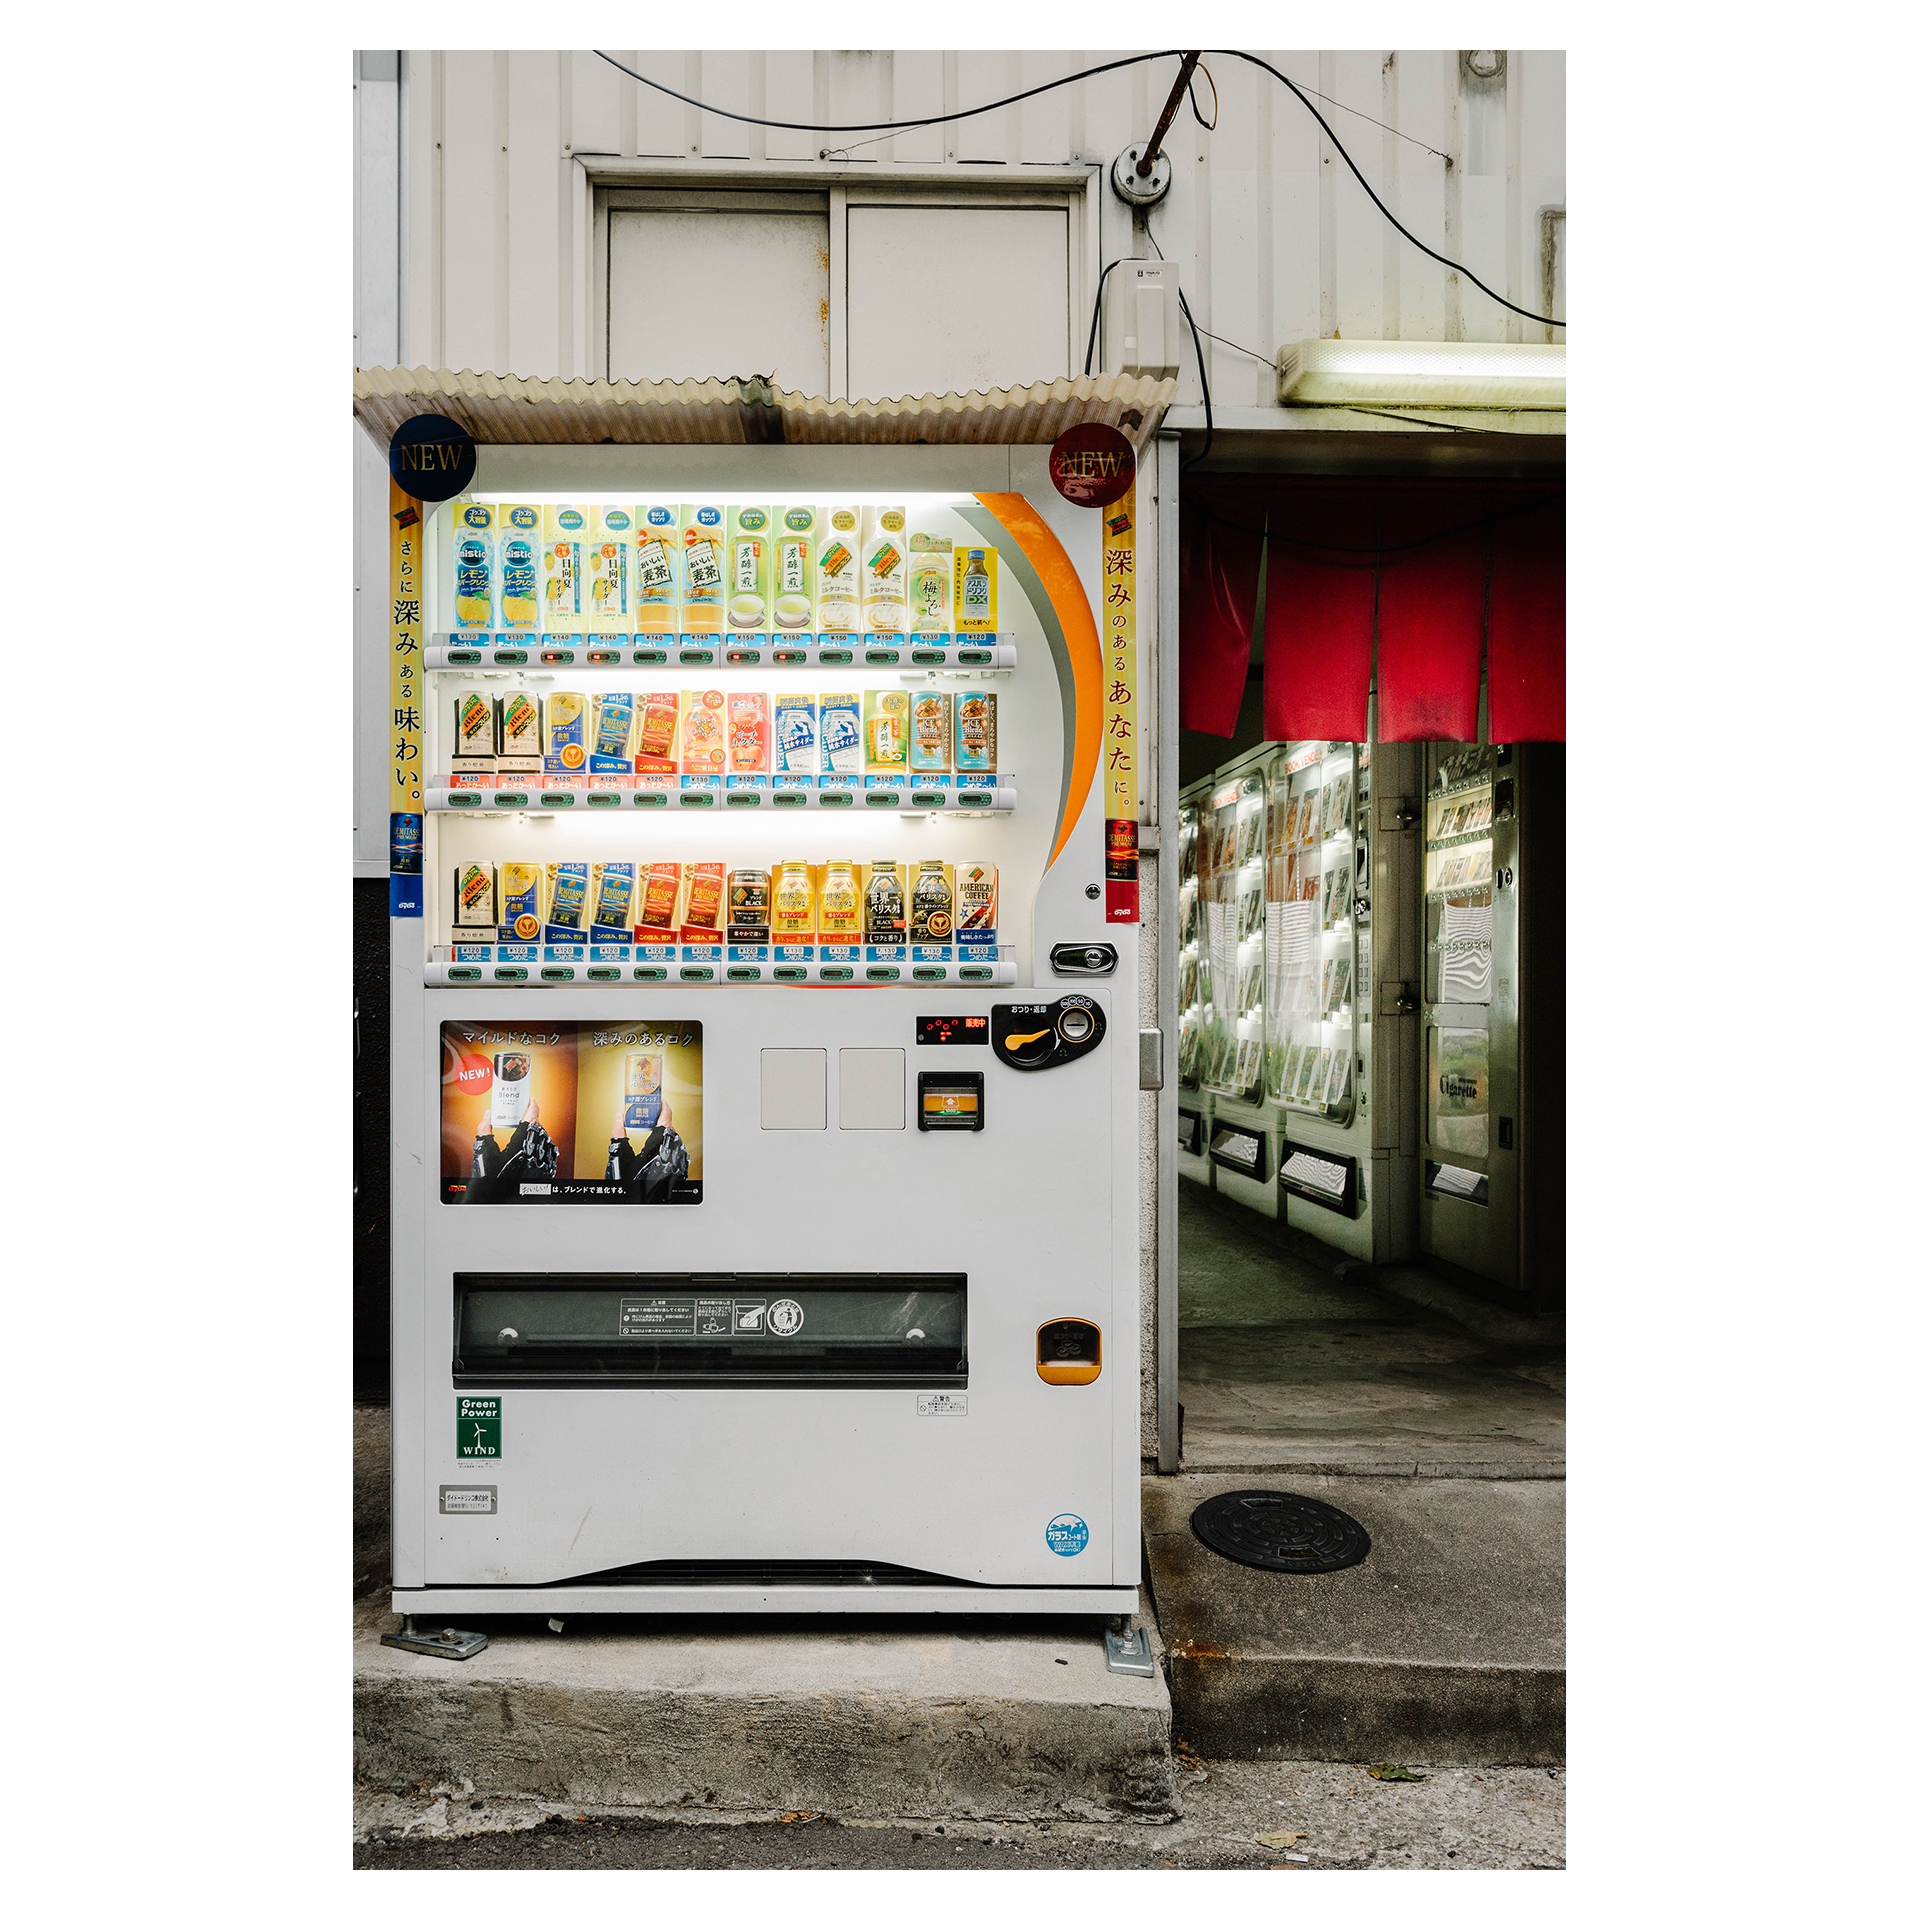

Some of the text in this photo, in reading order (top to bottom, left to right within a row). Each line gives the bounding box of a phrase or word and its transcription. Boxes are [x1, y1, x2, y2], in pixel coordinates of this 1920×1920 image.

[401, 444, 464, 471] NEW
[1061, 451, 1124, 478] NEW
[640, 554, 664, 569] おいしい
[689, 555, 714, 569] おいしい
[460, 569, 488, 579] レモン
[506, 569, 534, 579] レモン
[562, 559, 572, 589] 日向夏
[608, 559, 618, 589] 日向夏
[642, 564, 668, 581] 麦茶
[692, 564, 718, 582] 麦茶
[966, 580, 987, 588] アスパラ
[966, 587, 987, 595] ドリンク
[966, 595, 987, 604] DX
[393, 541, 421, 800] さらに深みある味わい。
[1105, 549, 1134, 806] 深みのあるあなたに。
[463, 703, 485, 728] Blend
[510, 703, 532, 728] Blend
[736, 731, 758, 739] ピーチ
[732, 738, 763, 747] ネクター
[1284, 761, 1300, 774] BOOK
[463, 873, 486, 898] Blend
[959, 883, 994, 892] AMERICAN
[870, 892, 900, 904] 世界一の
[964, 891, 990, 900] COFFEE
[1011, 1005, 1047, 1013] おつり・返却
[965, 1017, 987, 1028] 販売中
[463, 1031, 560, 1046] マイルドなコク
[593, 1031, 693, 1047] 深みのあるコク
[459, 1067, 491, 1082] NEW!
[1439, 1075, 1477, 1099] Cigarette
[552, 1186, 627, 1194] は、ブレンドで進化する。
[461, 1399, 496, 1408] Green
[461, 1408, 498, 1417] Power
[463, 1446, 496, 1455] WIND
